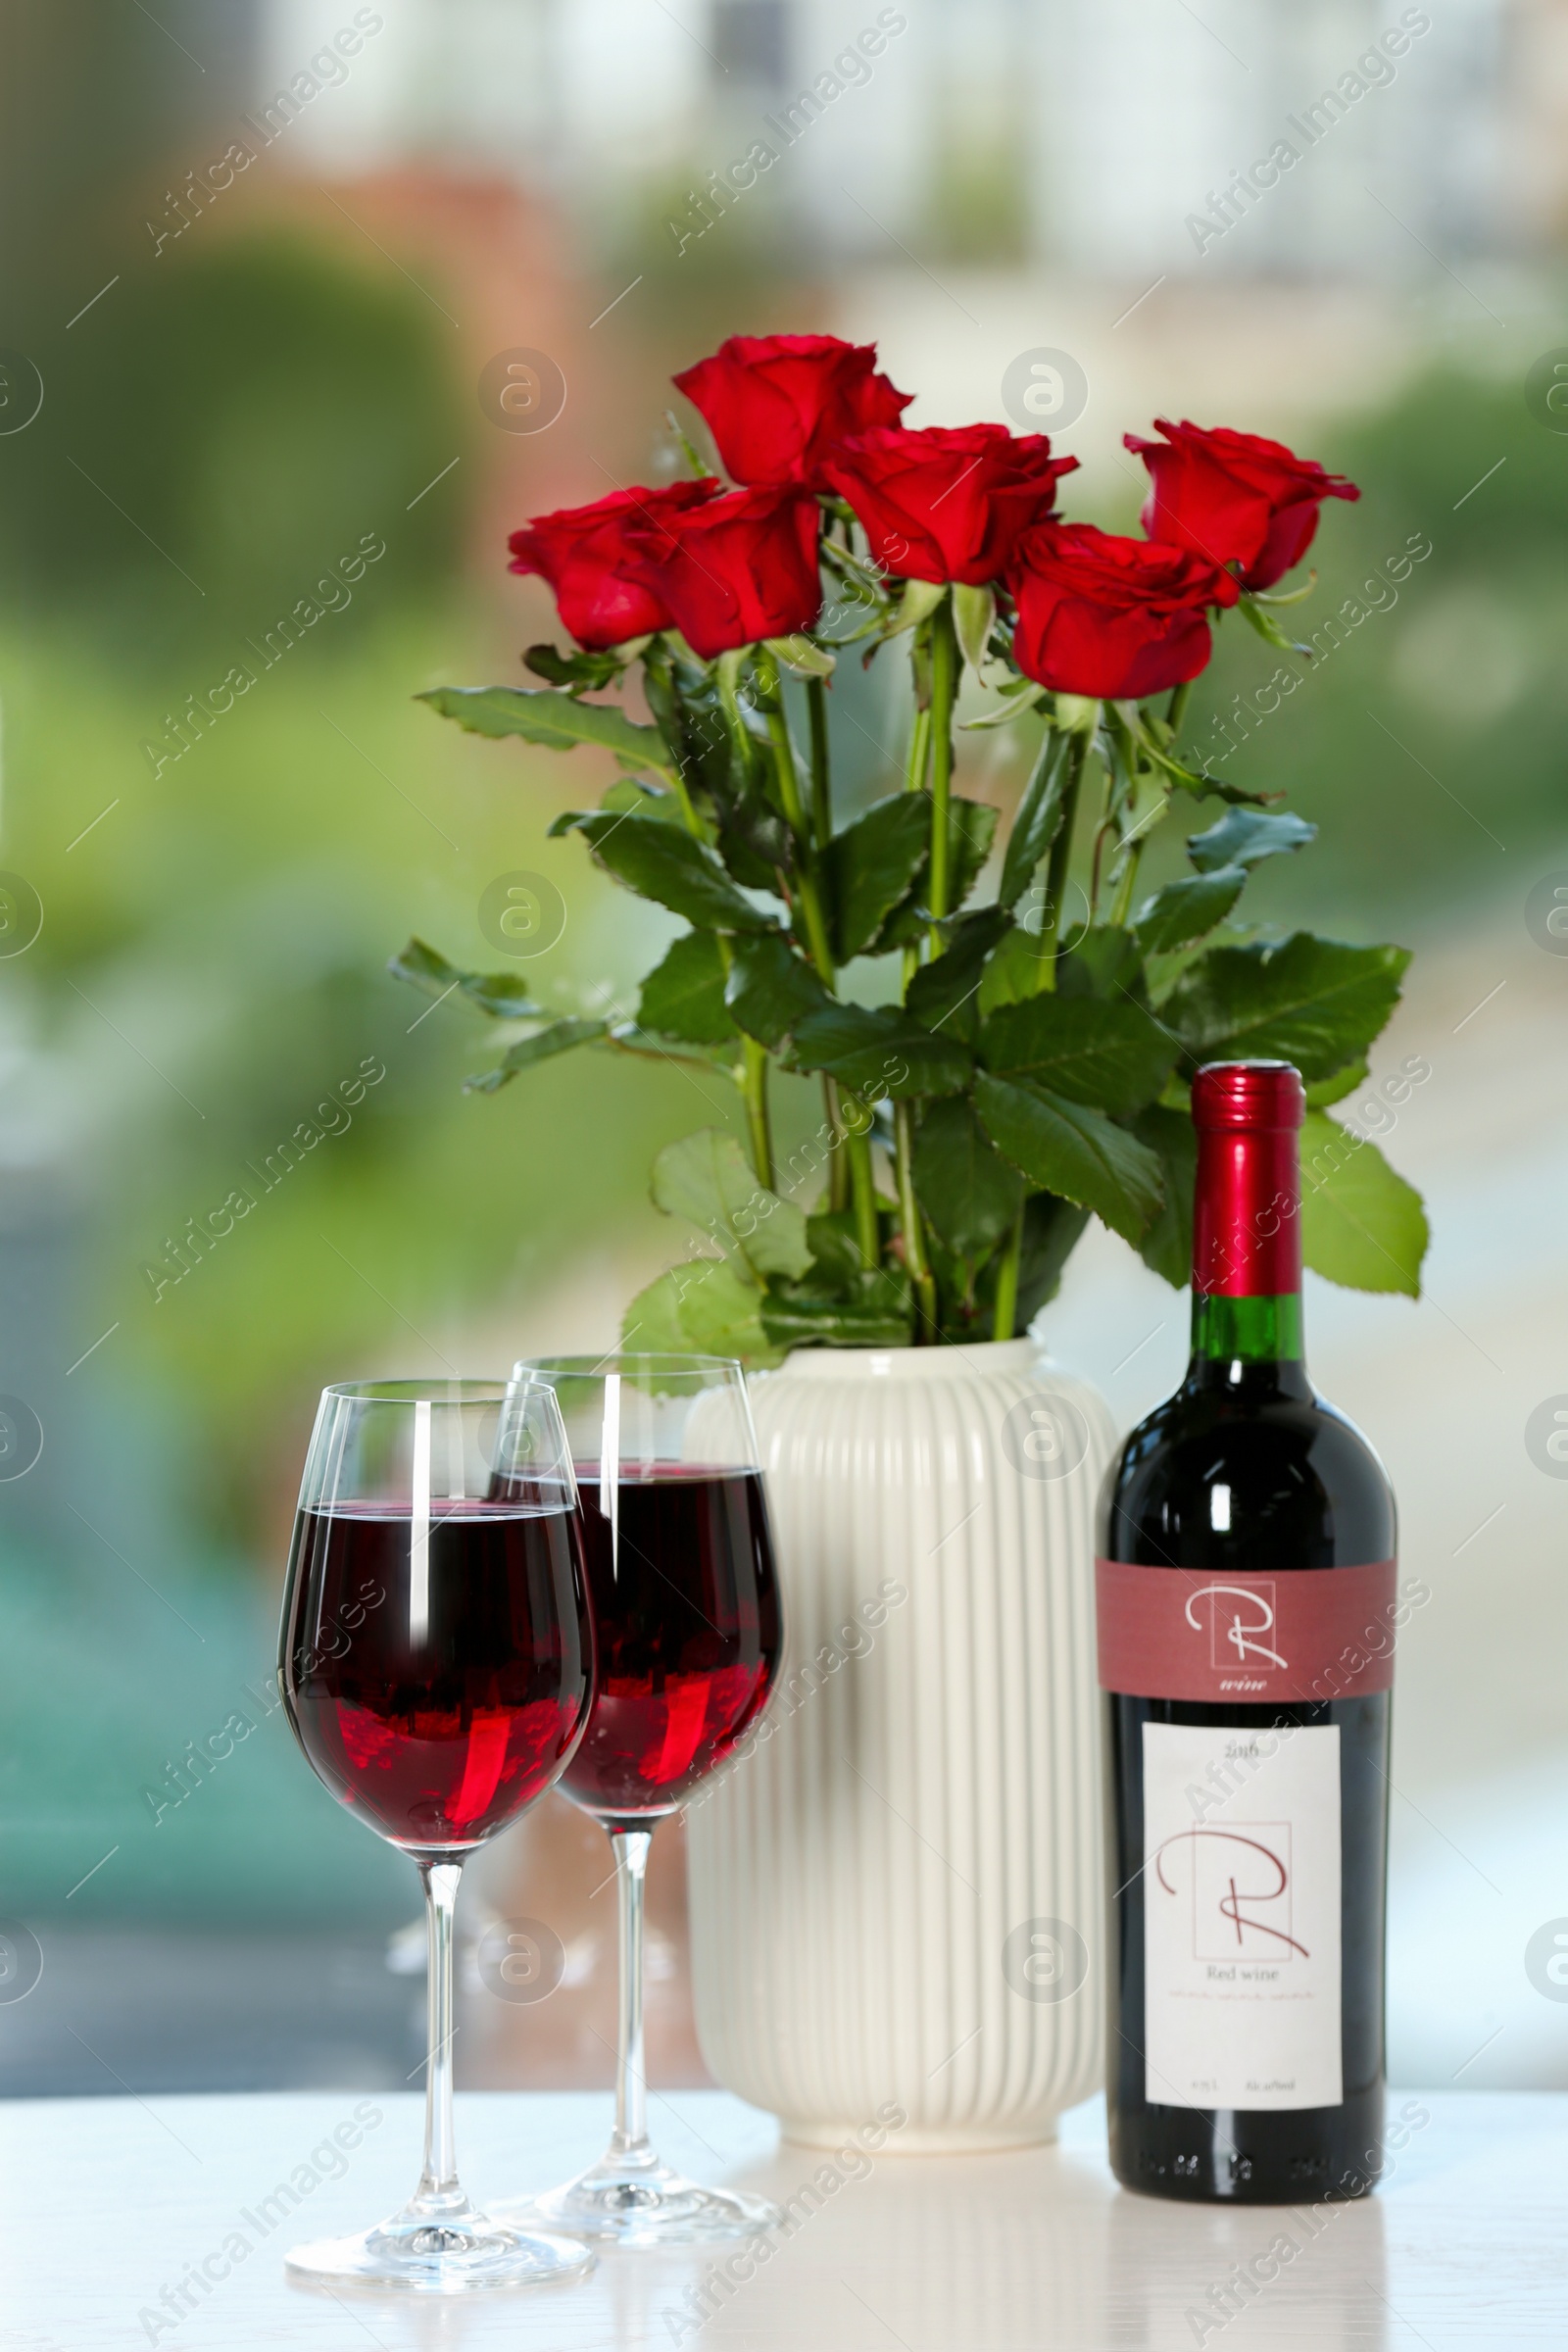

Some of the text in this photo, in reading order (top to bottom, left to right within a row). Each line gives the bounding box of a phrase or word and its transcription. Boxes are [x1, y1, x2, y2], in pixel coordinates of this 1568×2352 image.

[1185, 1586, 1288, 1669] R
[1219, 1675, 1268, 1691] wine
[1156, 1831, 1310, 1958] R
[1206, 1965, 1279, 1981] Red wine
